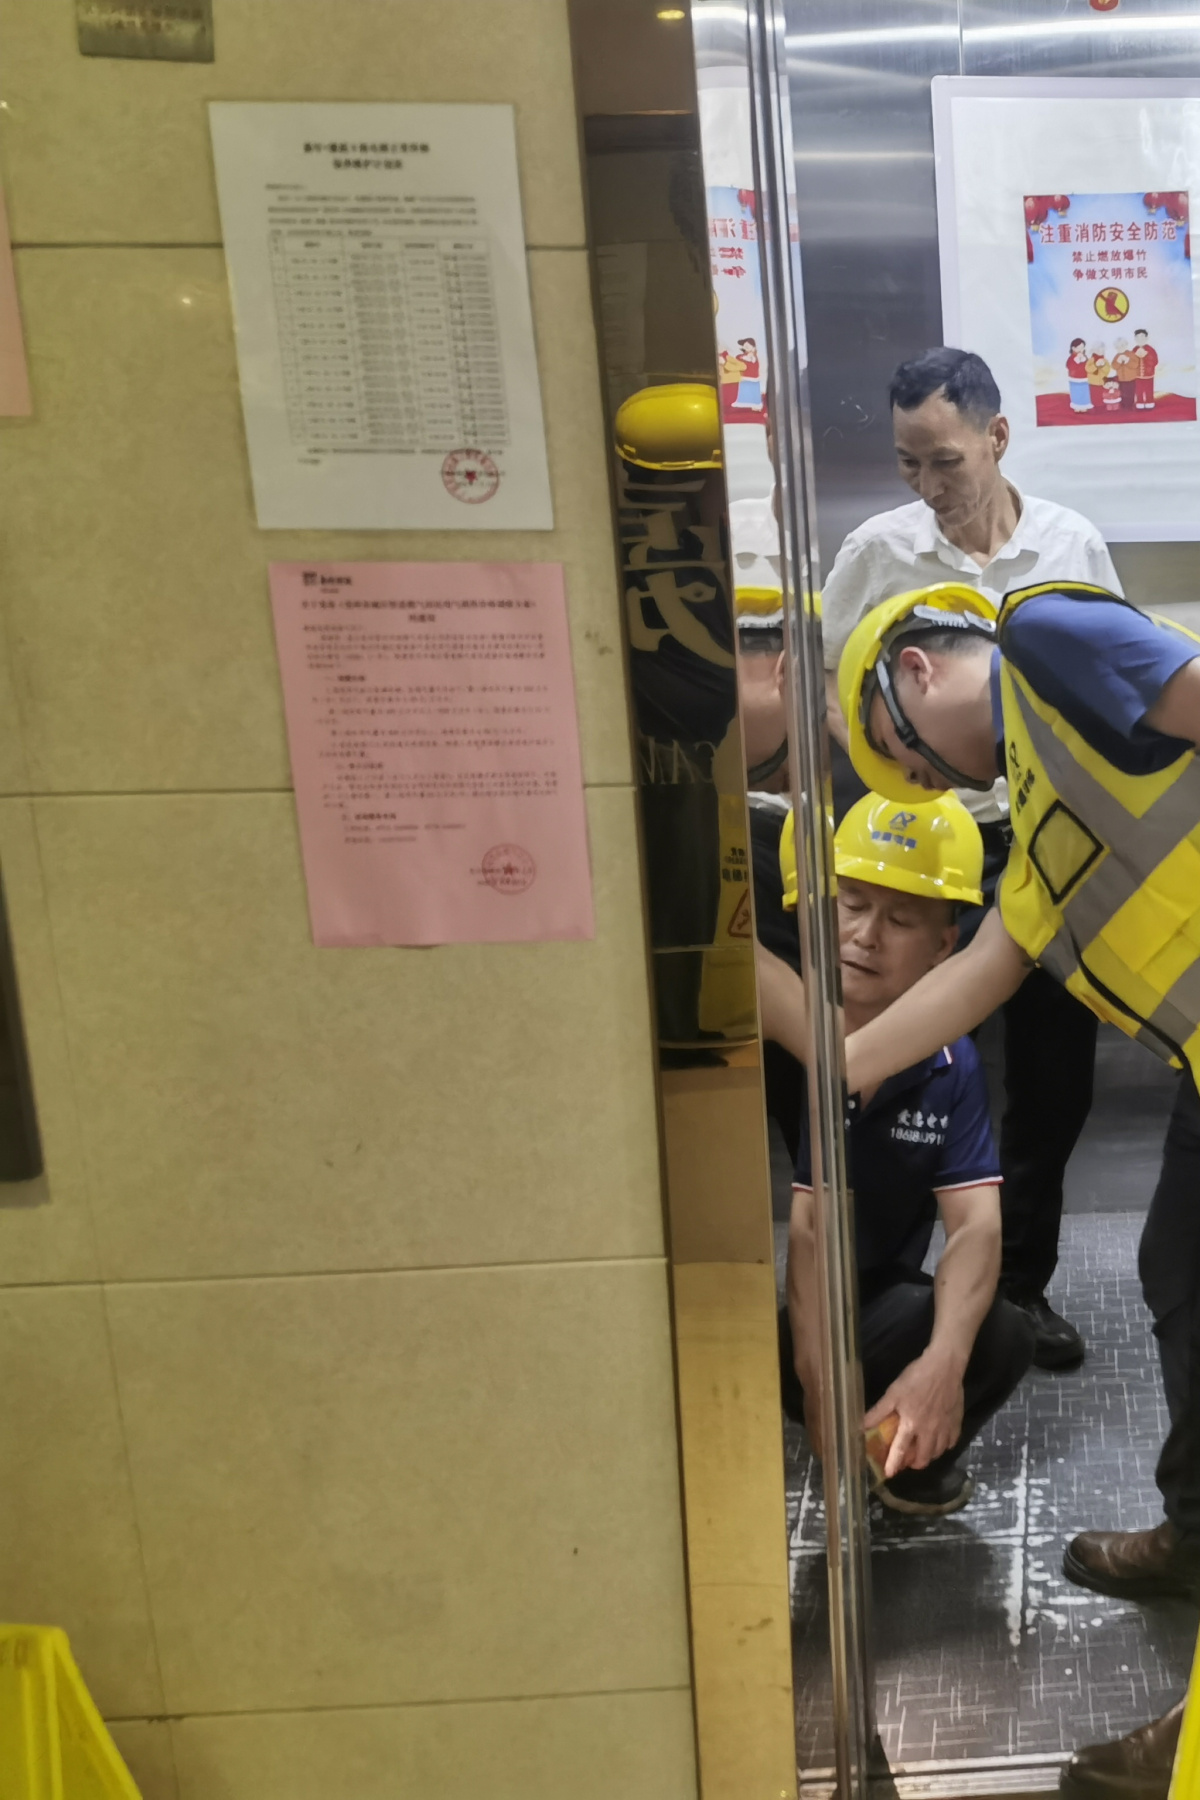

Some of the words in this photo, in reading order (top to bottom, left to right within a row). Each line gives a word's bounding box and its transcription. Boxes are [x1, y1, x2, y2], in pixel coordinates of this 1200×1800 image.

[1040, 220, 1177, 244] 注重消防安全防范
[1072, 249, 1147, 263] 禁止燃放爆竹
[1072, 266, 1149, 281] 争做文明市民
